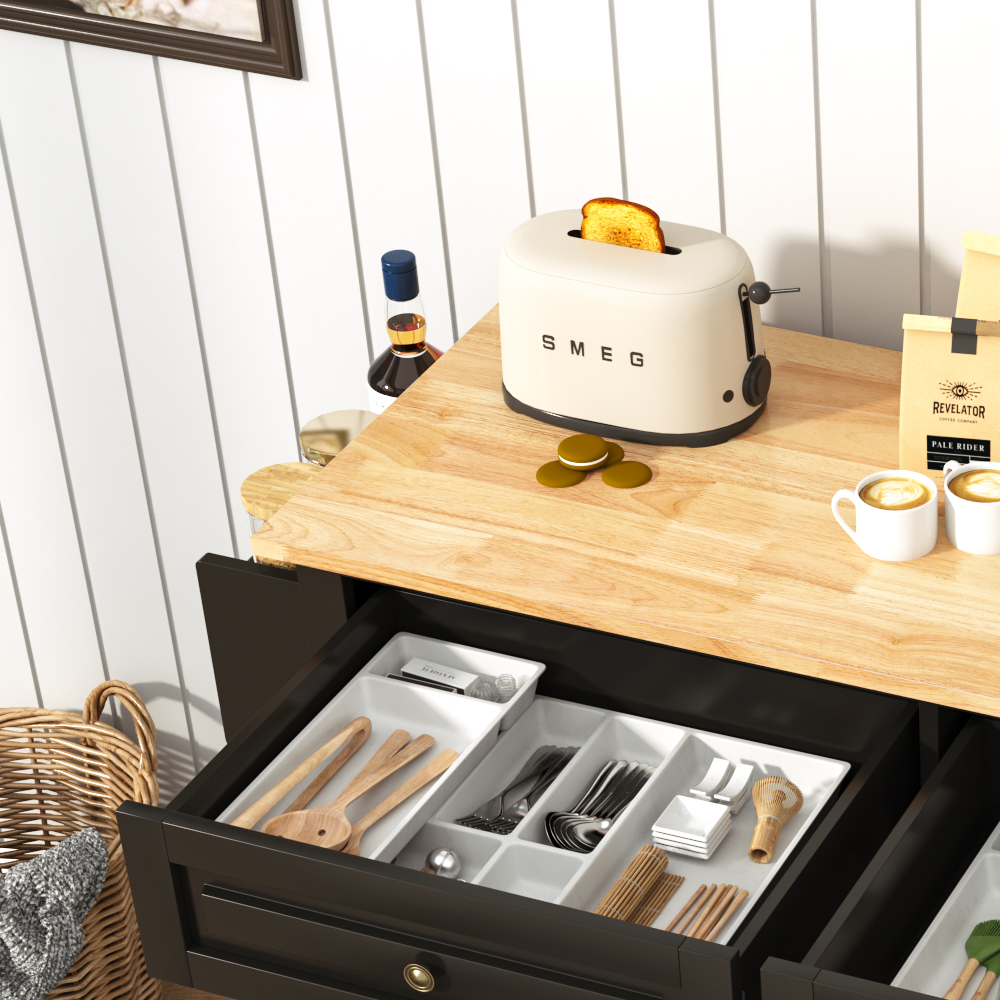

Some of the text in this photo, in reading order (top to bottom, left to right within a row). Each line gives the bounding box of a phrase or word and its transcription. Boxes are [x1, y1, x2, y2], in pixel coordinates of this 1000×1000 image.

[542, 334, 644, 368] SMEG
[933, 401, 986, 419] REVELATOR
[931, 440, 985, 452] PALE RIDER
